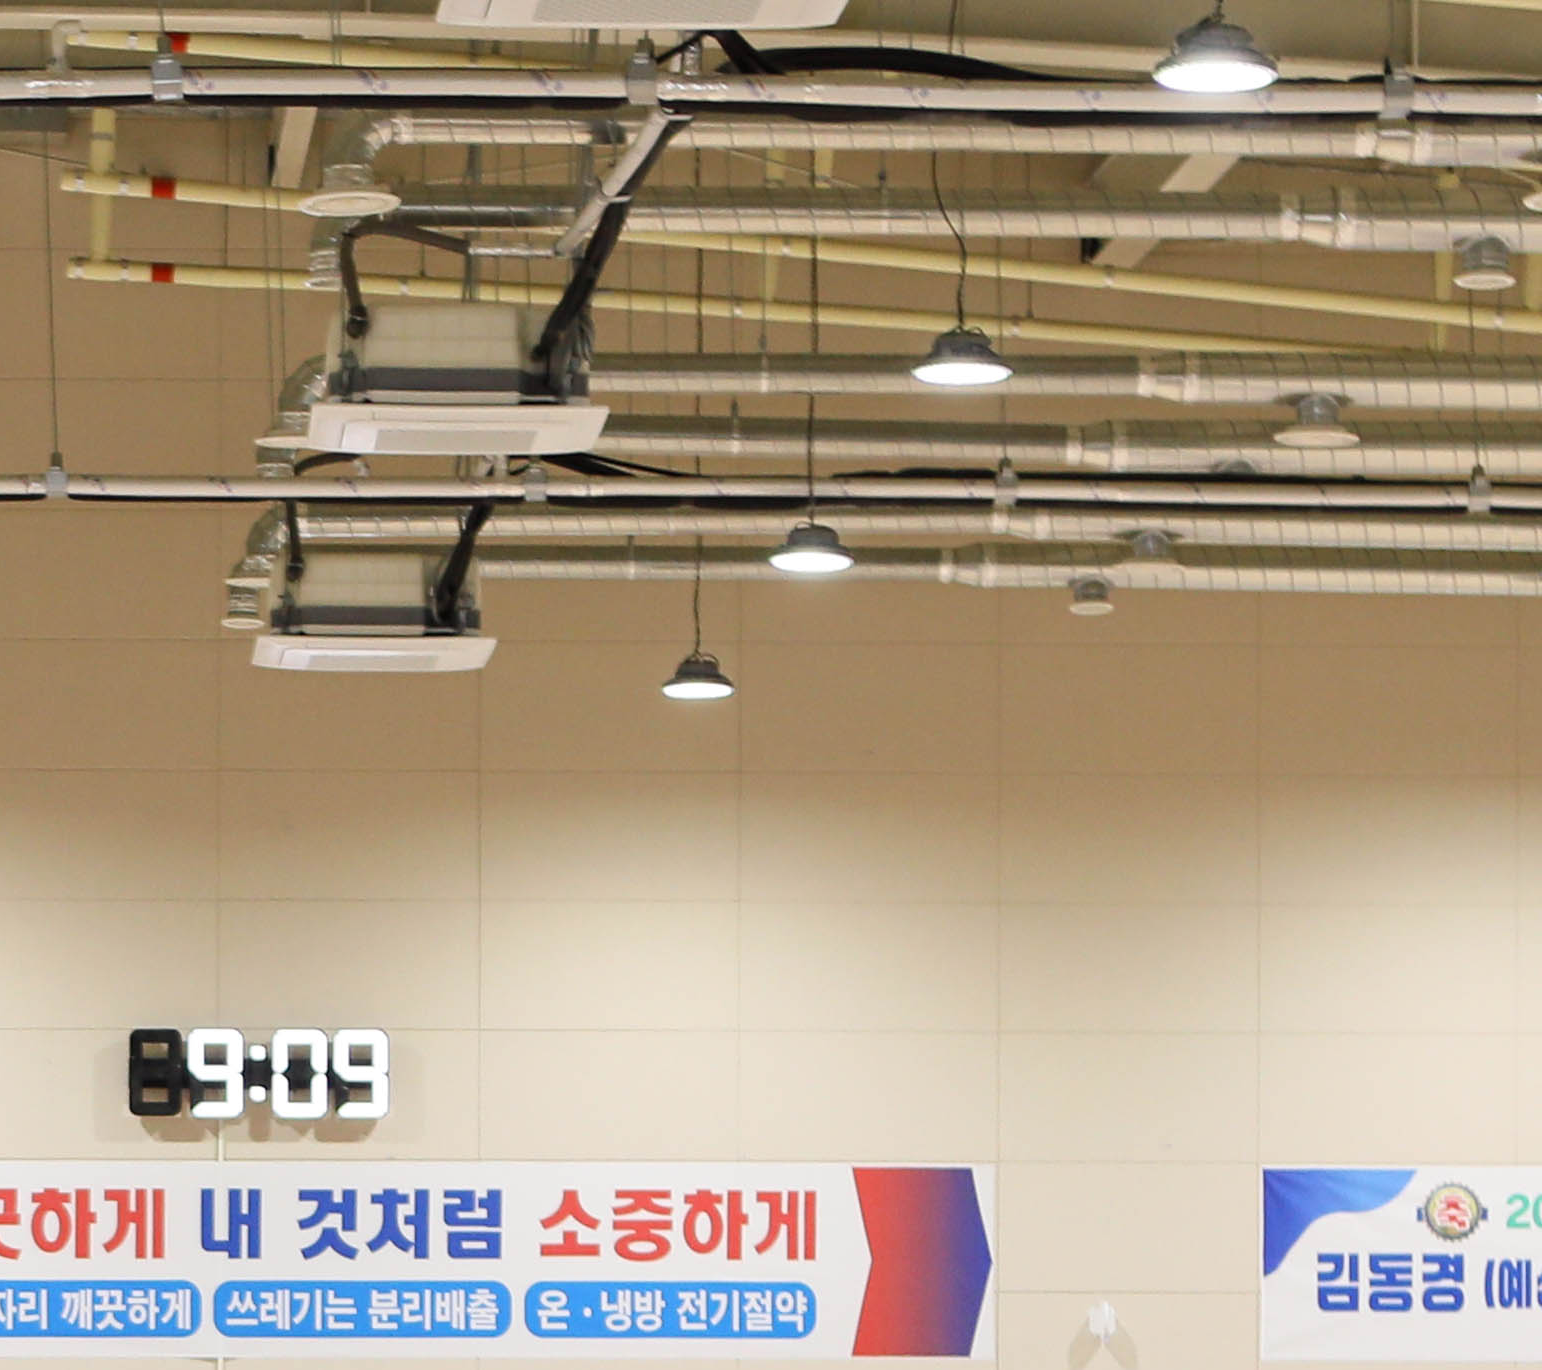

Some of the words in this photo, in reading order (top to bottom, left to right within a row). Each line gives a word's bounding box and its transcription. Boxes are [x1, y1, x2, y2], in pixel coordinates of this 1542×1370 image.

[200, 1188, 261, 1260] 내
[297, 1188, 503, 1260] 것처럼
[539, 1189, 817, 1262] 소중하게
[61, 1289, 192, 1331] 깨끗하게
[226, 1289, 358, 1331] 쓰레기는
[367, 1289, 500, 1331] 분리배출
[676, 1289, 808, 1331] 전기절약
[1317, 1252, 1465, 1313] 김동경
